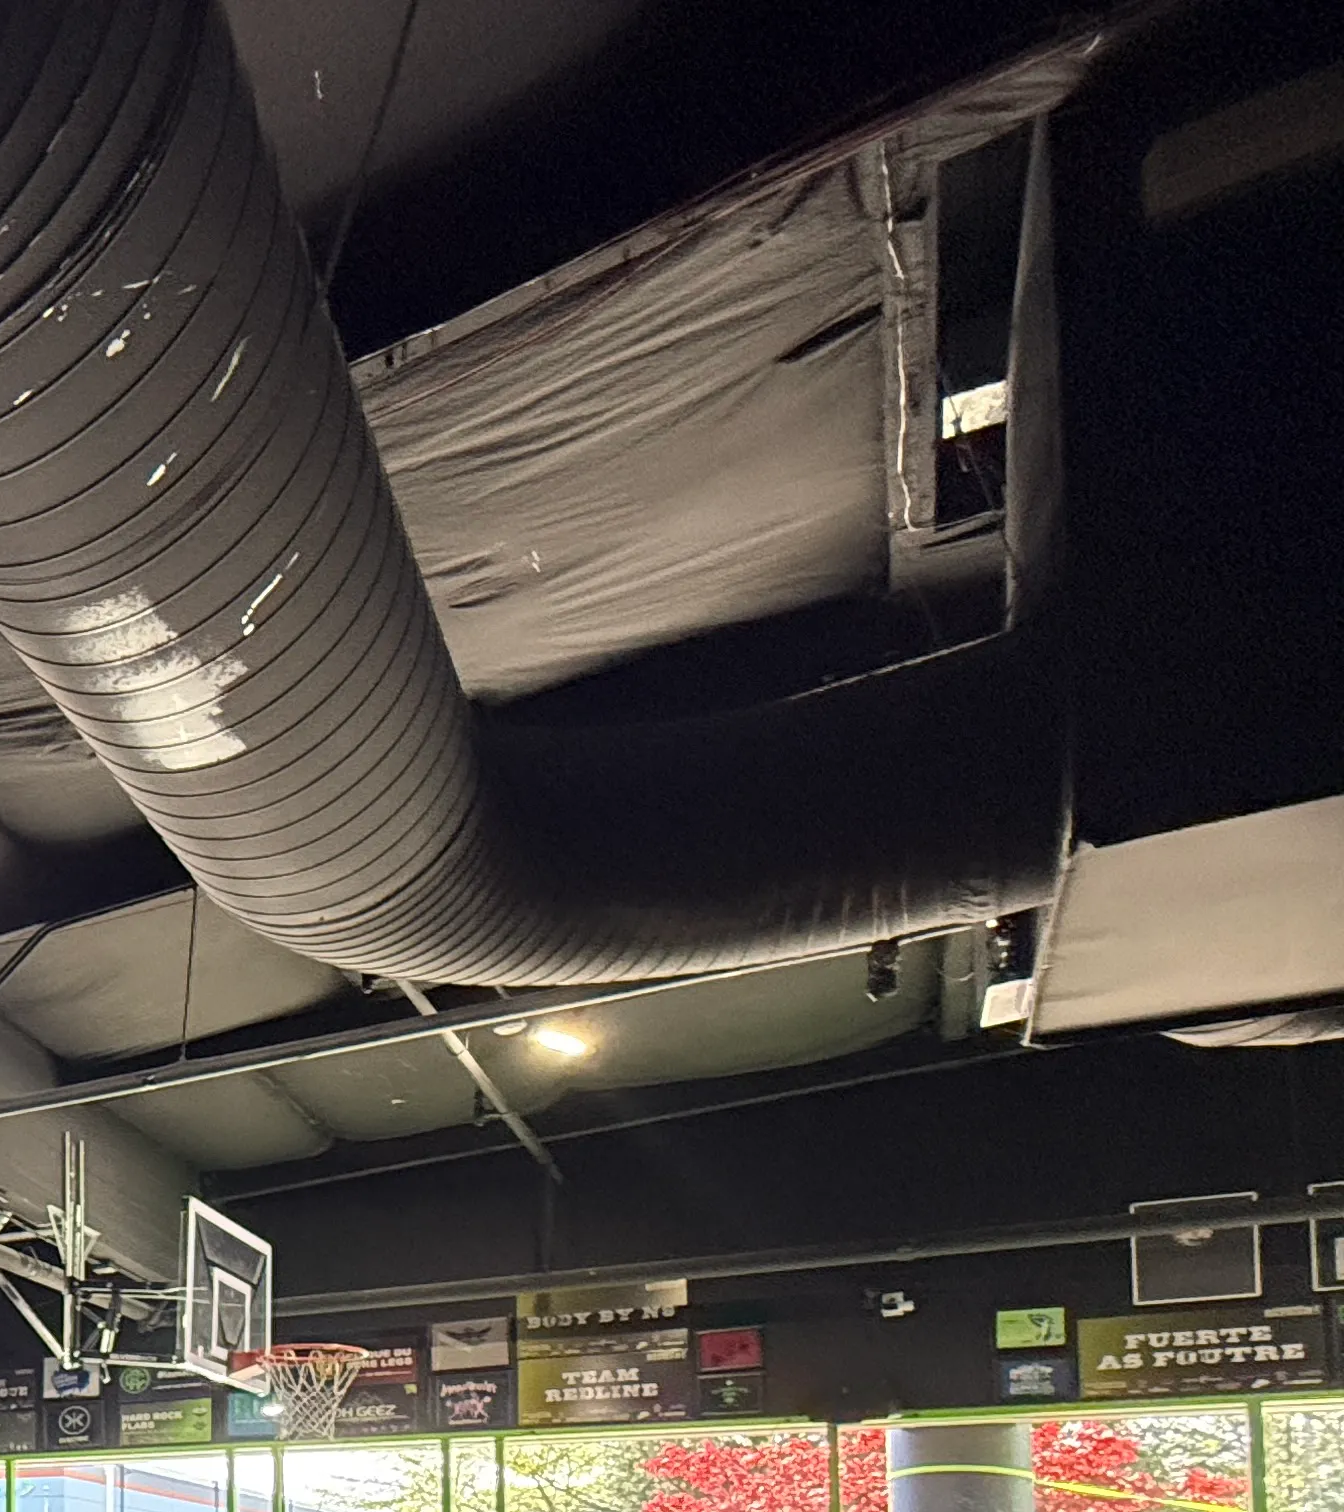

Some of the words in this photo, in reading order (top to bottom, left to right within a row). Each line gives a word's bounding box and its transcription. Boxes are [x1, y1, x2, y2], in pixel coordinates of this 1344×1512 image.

[527, 1312, 591, 1329] BODY
[599, 1308, 633, 1323] BY
[1124, 1325, 1272, 1349] FUERTE
[1097, 1353, 1143, 1371] AS
[1152, 1343, 1305, 1367] FOUTRE
[562, 1368, 639, 1385] TEAM
[545, 1383, 658, 1402] REDLINE
[356, 1404, 396, 1417] GEEZ
